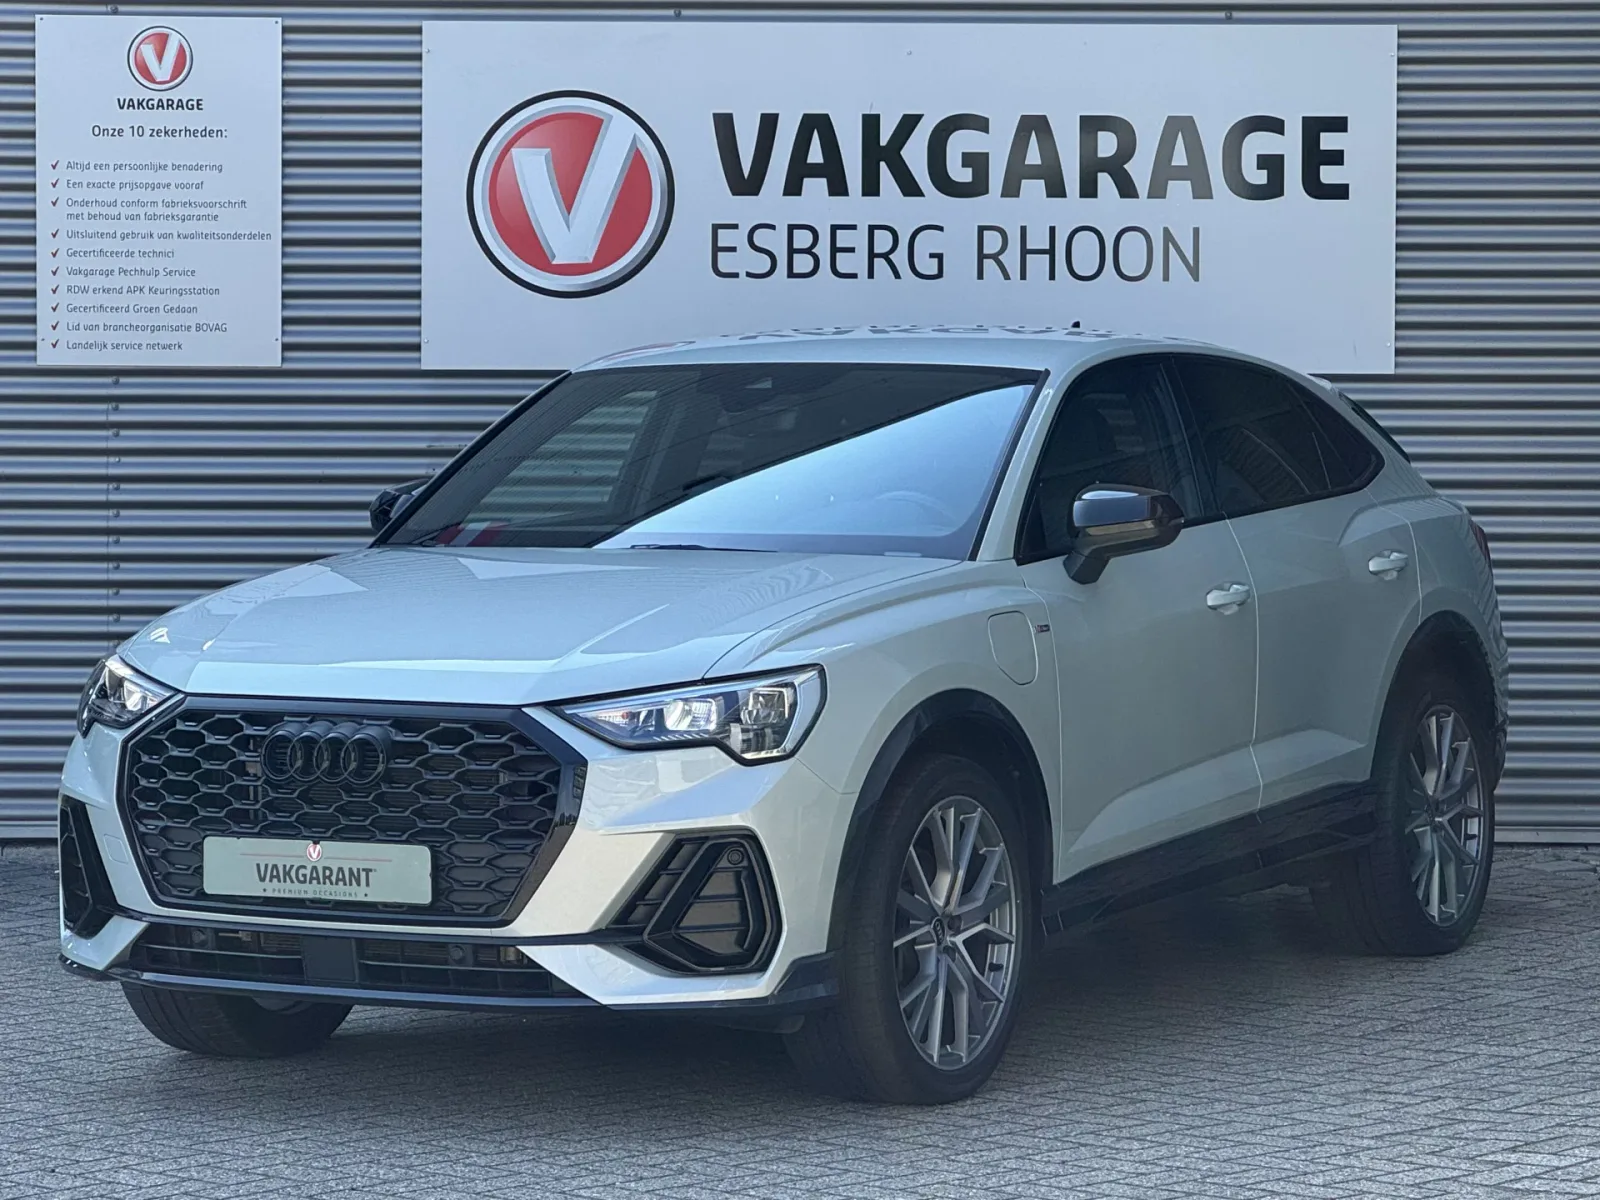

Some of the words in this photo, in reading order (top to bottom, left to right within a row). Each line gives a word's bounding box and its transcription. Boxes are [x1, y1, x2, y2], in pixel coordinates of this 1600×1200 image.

[116, 97, 204, 111] VAKGARAGE
[91, 124, 125, 138] Onze
[128, 125, 145, 138] 10
[148, 125, 228, 139] zekerheden:
[713, 113, 1349, 200] VAKGARAGE
[65, 160, 91, 173] Altijd
[93, 162, 111, 171] een
[112, 161, 169, 174] persoonlijke
[171, 161, 223, 174] benadering
[66, 178, 84, 189] Een
[86, 180, 116, 190] exacte
[118, 180, 172, 192] prijsopgave
[174, 179, 205, 191] vooraf
[66, 197, 118, 208] Onderhoud
[120, 198, 159, 209] conform
[161, 198, 248, 209] fabrieksvoorschrift
[66, 212, 85, 221] met
[87, 210, 122, 221] behoud
[124, 213, 141, 222] van
[143, 211, 219, 224] fabrieksgarantie
[66, 229, 117, 240] Uitsluitend
[119, 229, 155, 242] gebruik
[156, 232, 174, 240] van
[176, 230, 272, 241] kwaliteitsonderdelen
[66, 247, 136, 259] Gecertificeerde
[137, 248, 175, 259] technici
[711, 223, 944, 280] ESBERG
[977, 225, 1199, 282] RHOON
[65, 266, 116, 279] Vakgarage
[118, 266, 161, 279] Pechhulp
[162, 266, 196, 278] Service
[66, 284, 90, 295] RDW
[92, 285, 124, 295] erkend
[125, 285, 146, 295] APK
[148, 285, 220, 298] Keuringsstation
[66, 303, 130, 314] Gecertificeerd
[132, 303, 161, 314] Groen
[162, 303, 198, 314] Gedaan
[66, 321, 81, 332] Lid
[83, 323, 100, 332] van
[102, 322, 193, 335] brancheorganisatie
[194, 322, 228, 333] BOVAG
[66, 339, 109, 352] Landelijk
[110, 340, 144, 351] service
[145, 341, 183, 351] netwerk
[256, 863, 373, 887] VAKGARANT
[272, 887, 309, 896] PREMIUM
[313, 888, 358, 898] OCCASIONS
